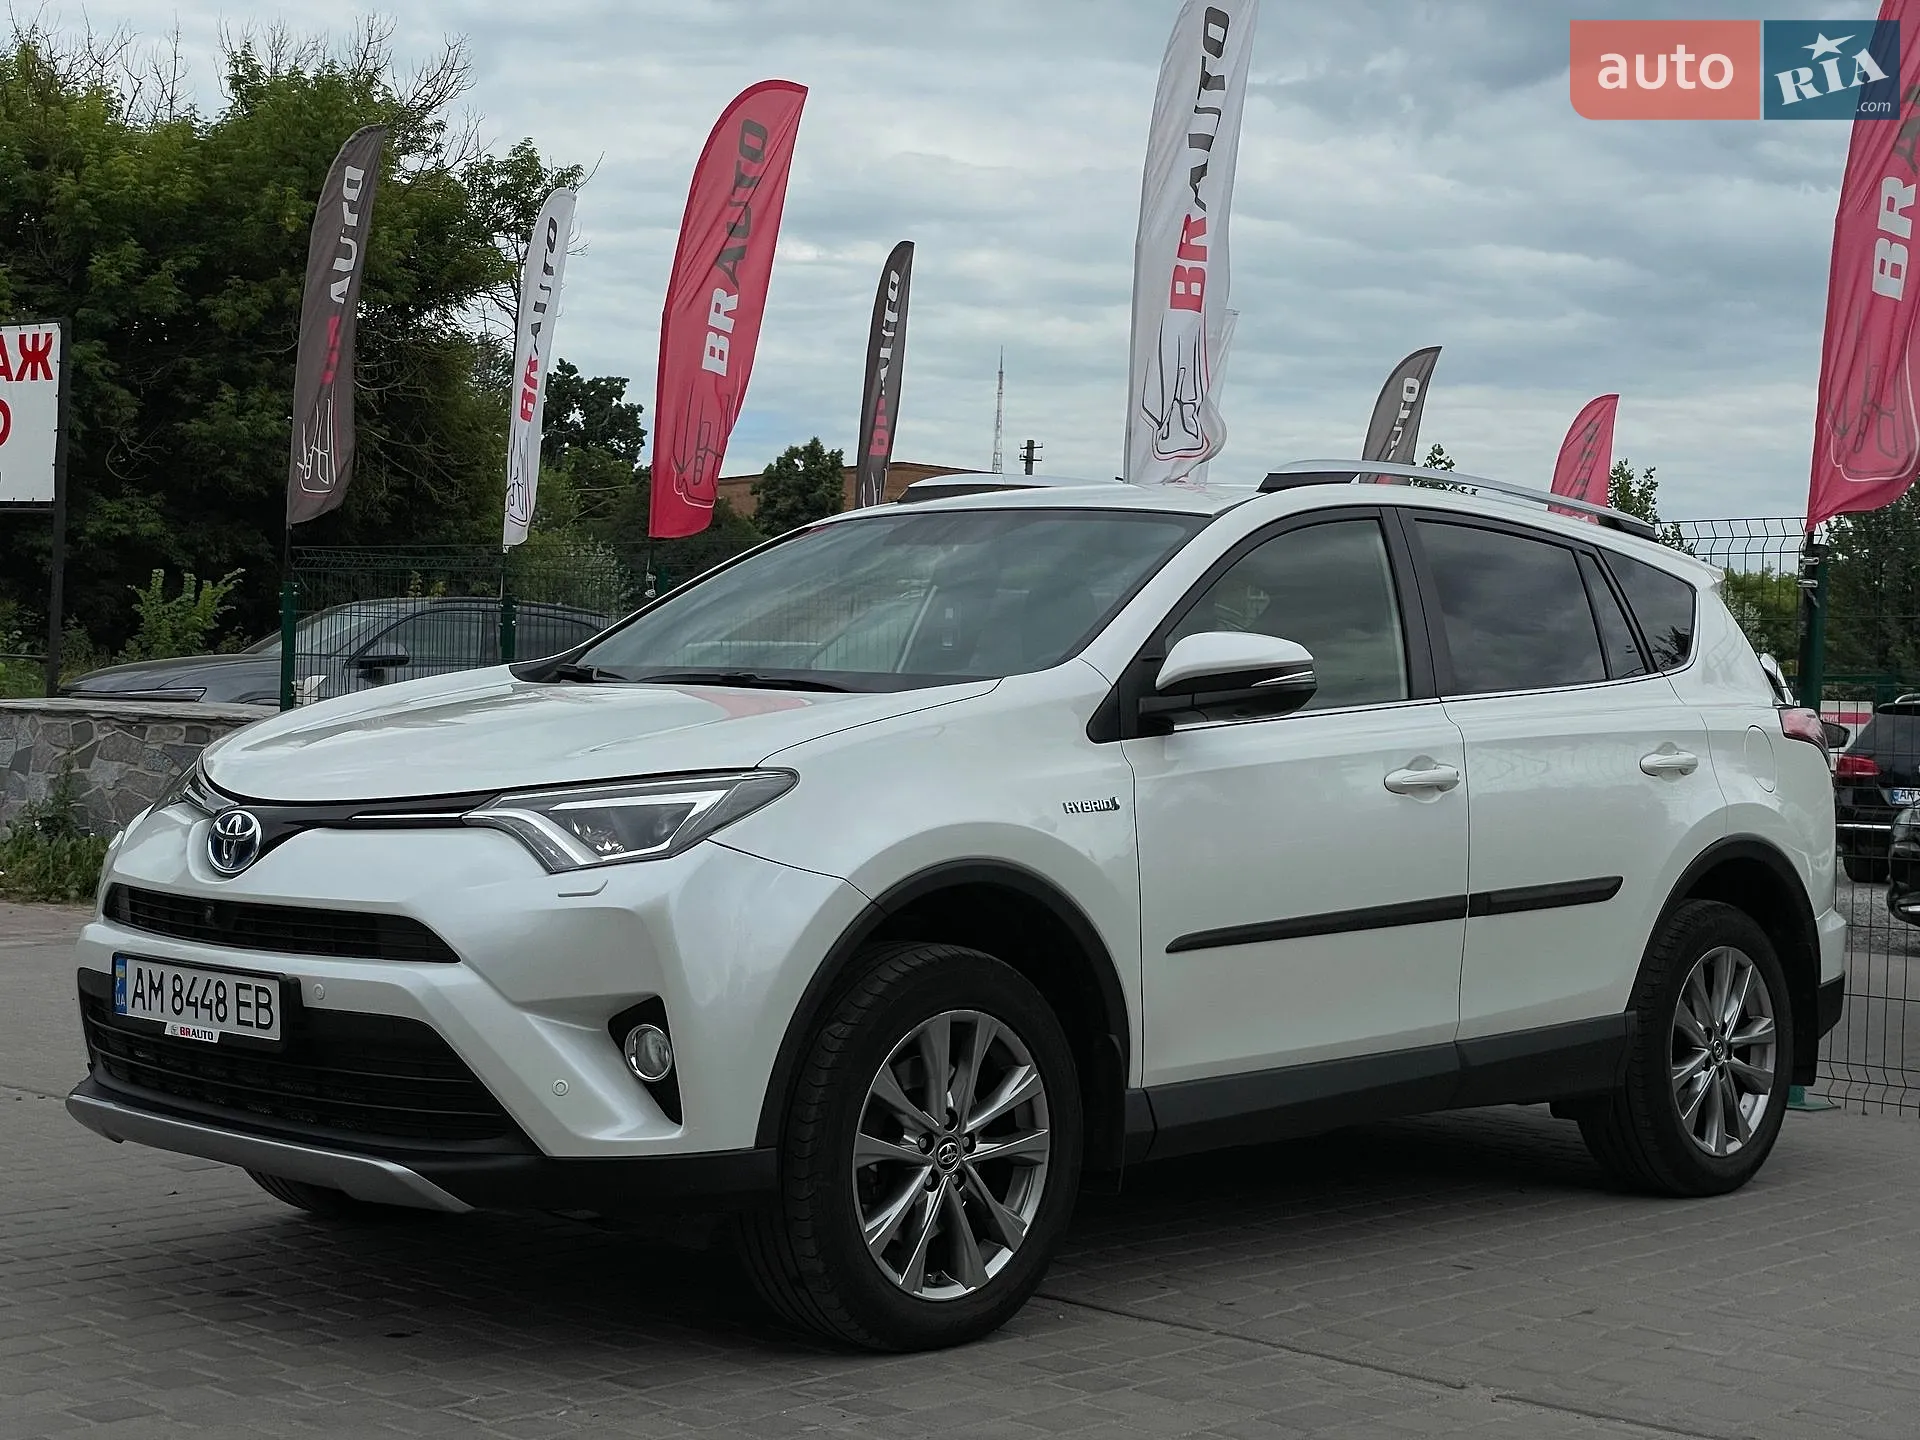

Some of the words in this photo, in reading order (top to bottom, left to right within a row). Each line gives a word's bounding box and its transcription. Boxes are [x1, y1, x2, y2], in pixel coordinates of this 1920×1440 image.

[1169, 6, 1230, 314] BRAUTO
[1871, 83, 1920, 302] BRA
[701, 119, 769, 377] BRAUTO
[1062, 799, 1113, 814] HYBRID
[131, 967, 164, 1013] AM
[171, 973, 228, 1023] 8448
[235, 982, 274, 1030] EB
[179, 1026, 214, 1041] BRAUTO
